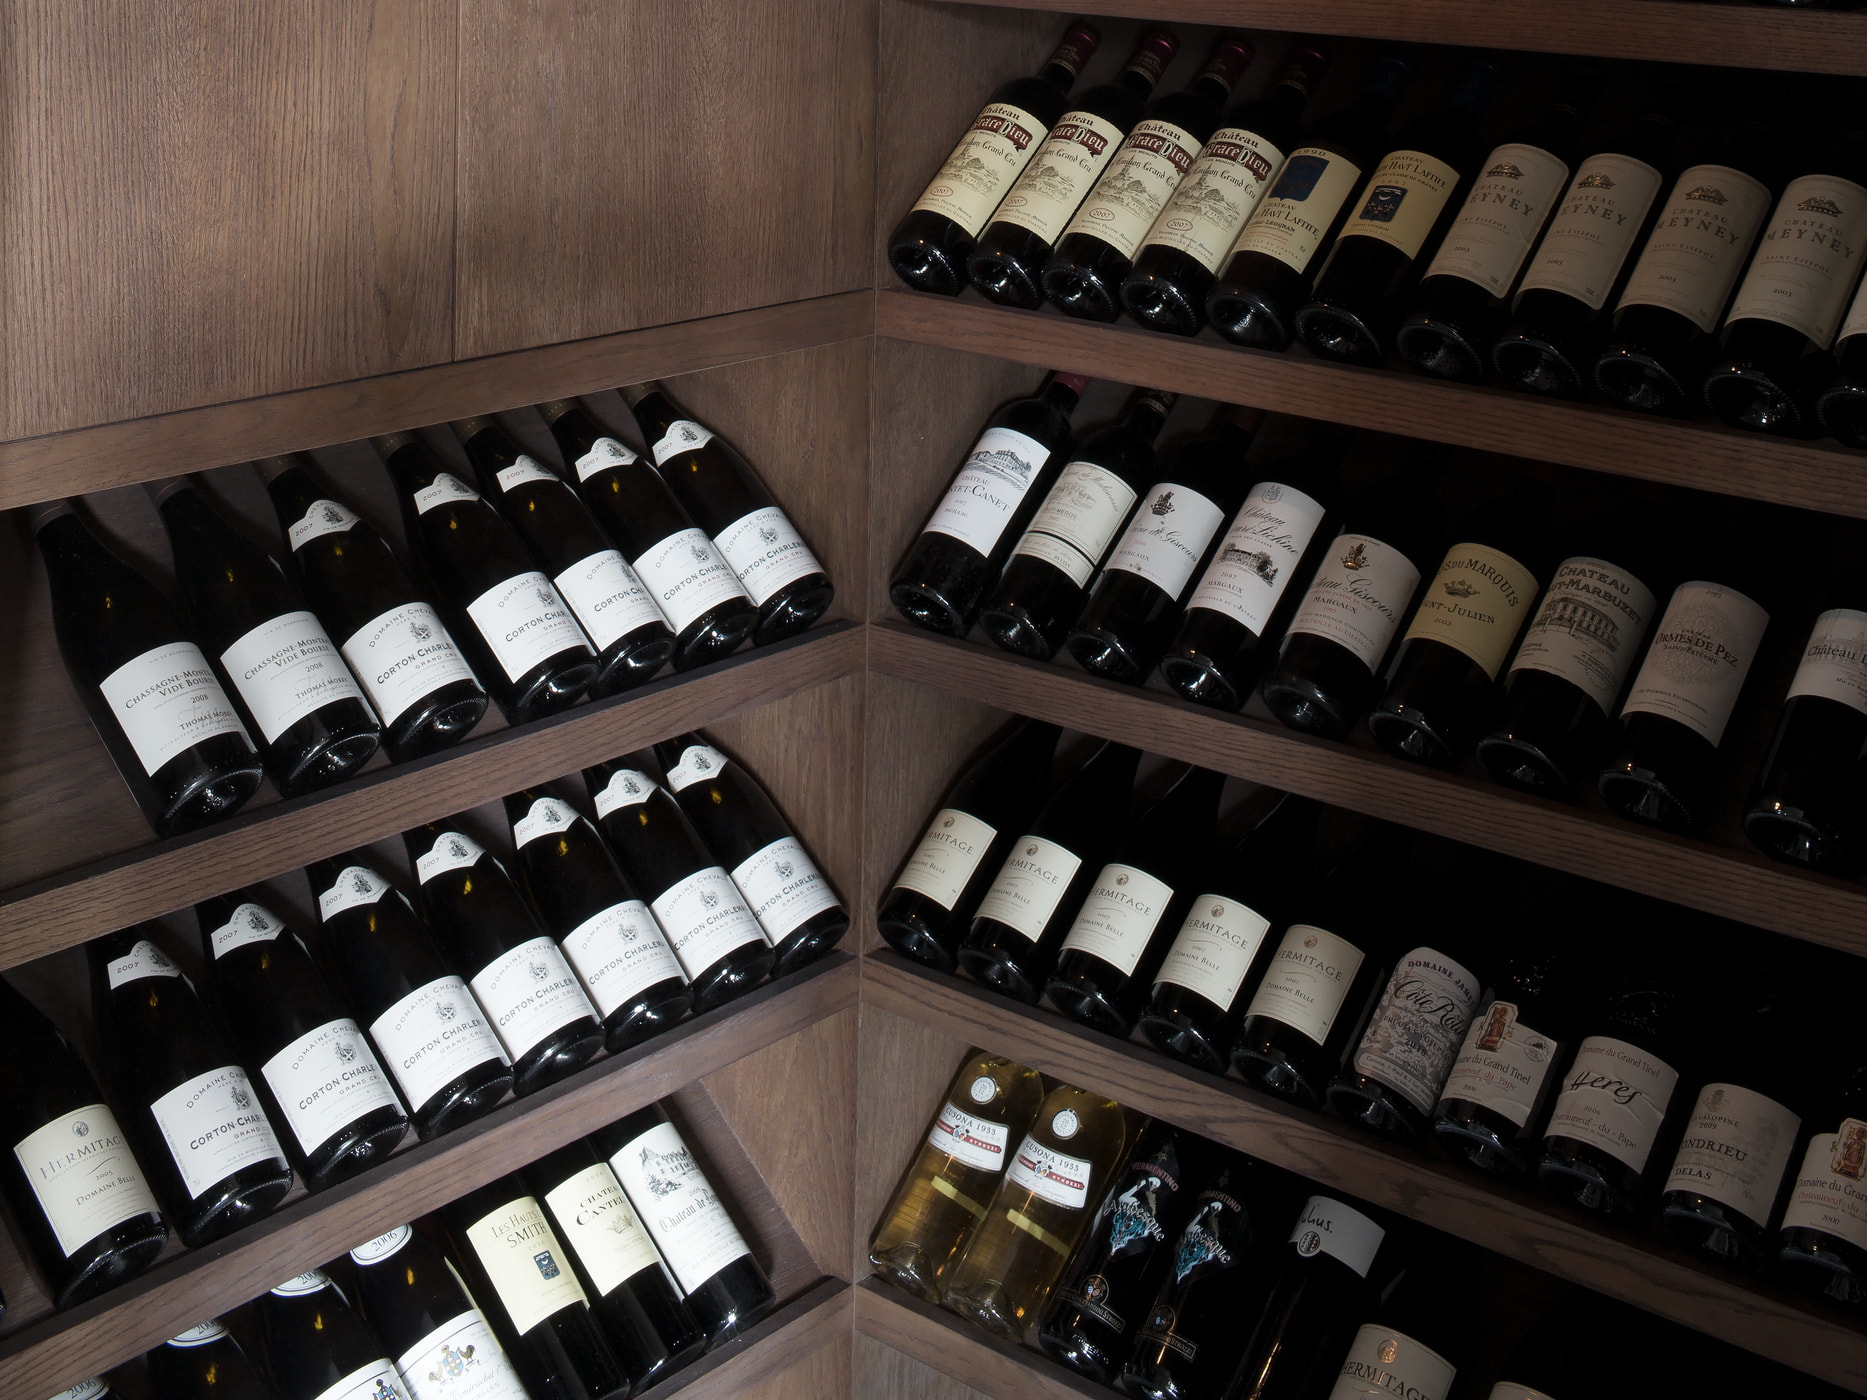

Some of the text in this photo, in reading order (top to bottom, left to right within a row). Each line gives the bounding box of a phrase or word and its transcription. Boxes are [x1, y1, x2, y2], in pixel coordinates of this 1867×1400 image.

[999, 120, 1032, 148] Dieu
[1073, 126, 1105, 152] Dieu
[1160, 137, 1191, 170] Dieu
[1237, 146, 1270, 177] Dieu
[1170, 220, 1189, 230] 2007
[1784, 218, 1843, 238] CHATEAU
[1772, 286, 1794, 298] 2003
[504, 468, 526, 482] 2007
[422, 488, 443, 503] 2007
[294, 521, 315, 538] 2007
[724, 519, 756, 555] DOMAINE
[655, 537, 686, 570] DOMAINE
[1463, 557, 1520, 609] MARQUIS
[1557, 564, 1631, 597] CHATEAU
[497, 577, 532, 609] DOMAINE
[1342, 572, 1397, 626] Giscours
[1312, 595, 1359, 615] MARGAUX
[367, 612, 406, 650] DOMAINE
[275, 653, 302, 671] VIDE
[414, 653, 443, 671] GRAND
[1693, 637, 1714, 654] DE
[1714, 641, 1740, 669] PEZ
[304, 662, 325, 675] 2008
[157, 682, 186, 698] VIDE
[189, 693, 210, 707] 2008
[294, 681, 328, 702] THOMAS
[179, 712, 212, 733] THOMAS
[740, 854, 773, 891] DOMAINE
[324, 892, 344, 908] 2007
[664, 883, 697, 919] DOMAINE
[217, 929, 239, 945] 2007
[581, 916, 614, 952] DOMAINE
[1104, 922, 1125, 939] BELLE
[115, 960, 140, 975] 2007
[489, 952, 523, 991] DOMAINE
[1201, 957, 1222, 973] BELLE
[1406, 958, 1455, 981] DOMAINE
[532, 993, 560, 1013] GRAND
[1294, 987, 1317, 1005] BELLE
[393, 991, 431, 1033] DOMAINE
[290, 1031, 331, 1072] DOMAINE
[438, 1034, 468, 1056] GRAND
[1482, 1055, 1513, 1077] Grand
[1510, 1068, 1533, 1087] Tinel
[1616, 1050, 1643, 1070] Grand
[1642, 1062, 1663, 1080] Tinel
[184, 1072, 227, 1111] DOMAINE
[338, 1078, 368, 1096] GRAND
[945, 1106, 975, 1130] CUSONA
[1698, 1121, 1718, 1131] 2009
[232, 1125, 261, 1140] GRAND
[1617, 1130, 1639, 1150] Pape
[1025, 1140, 1056, 1165] CUSONA
[95, 1169, 116, 1183] 2005
[1130, 1161, 1180, 1194] VERMENTINO
[1674, 1167, 1714, 1182] DELAS
[75, 1181, 118, 1208] DOMAINE
[490, 1210, 539, 1241] LES HAUTS
[1103, 1199, 1166, 1244] Arabesque
[371, 1229, 399, 1254] 2006
[505, 1221, 548, 1250] SMITH
